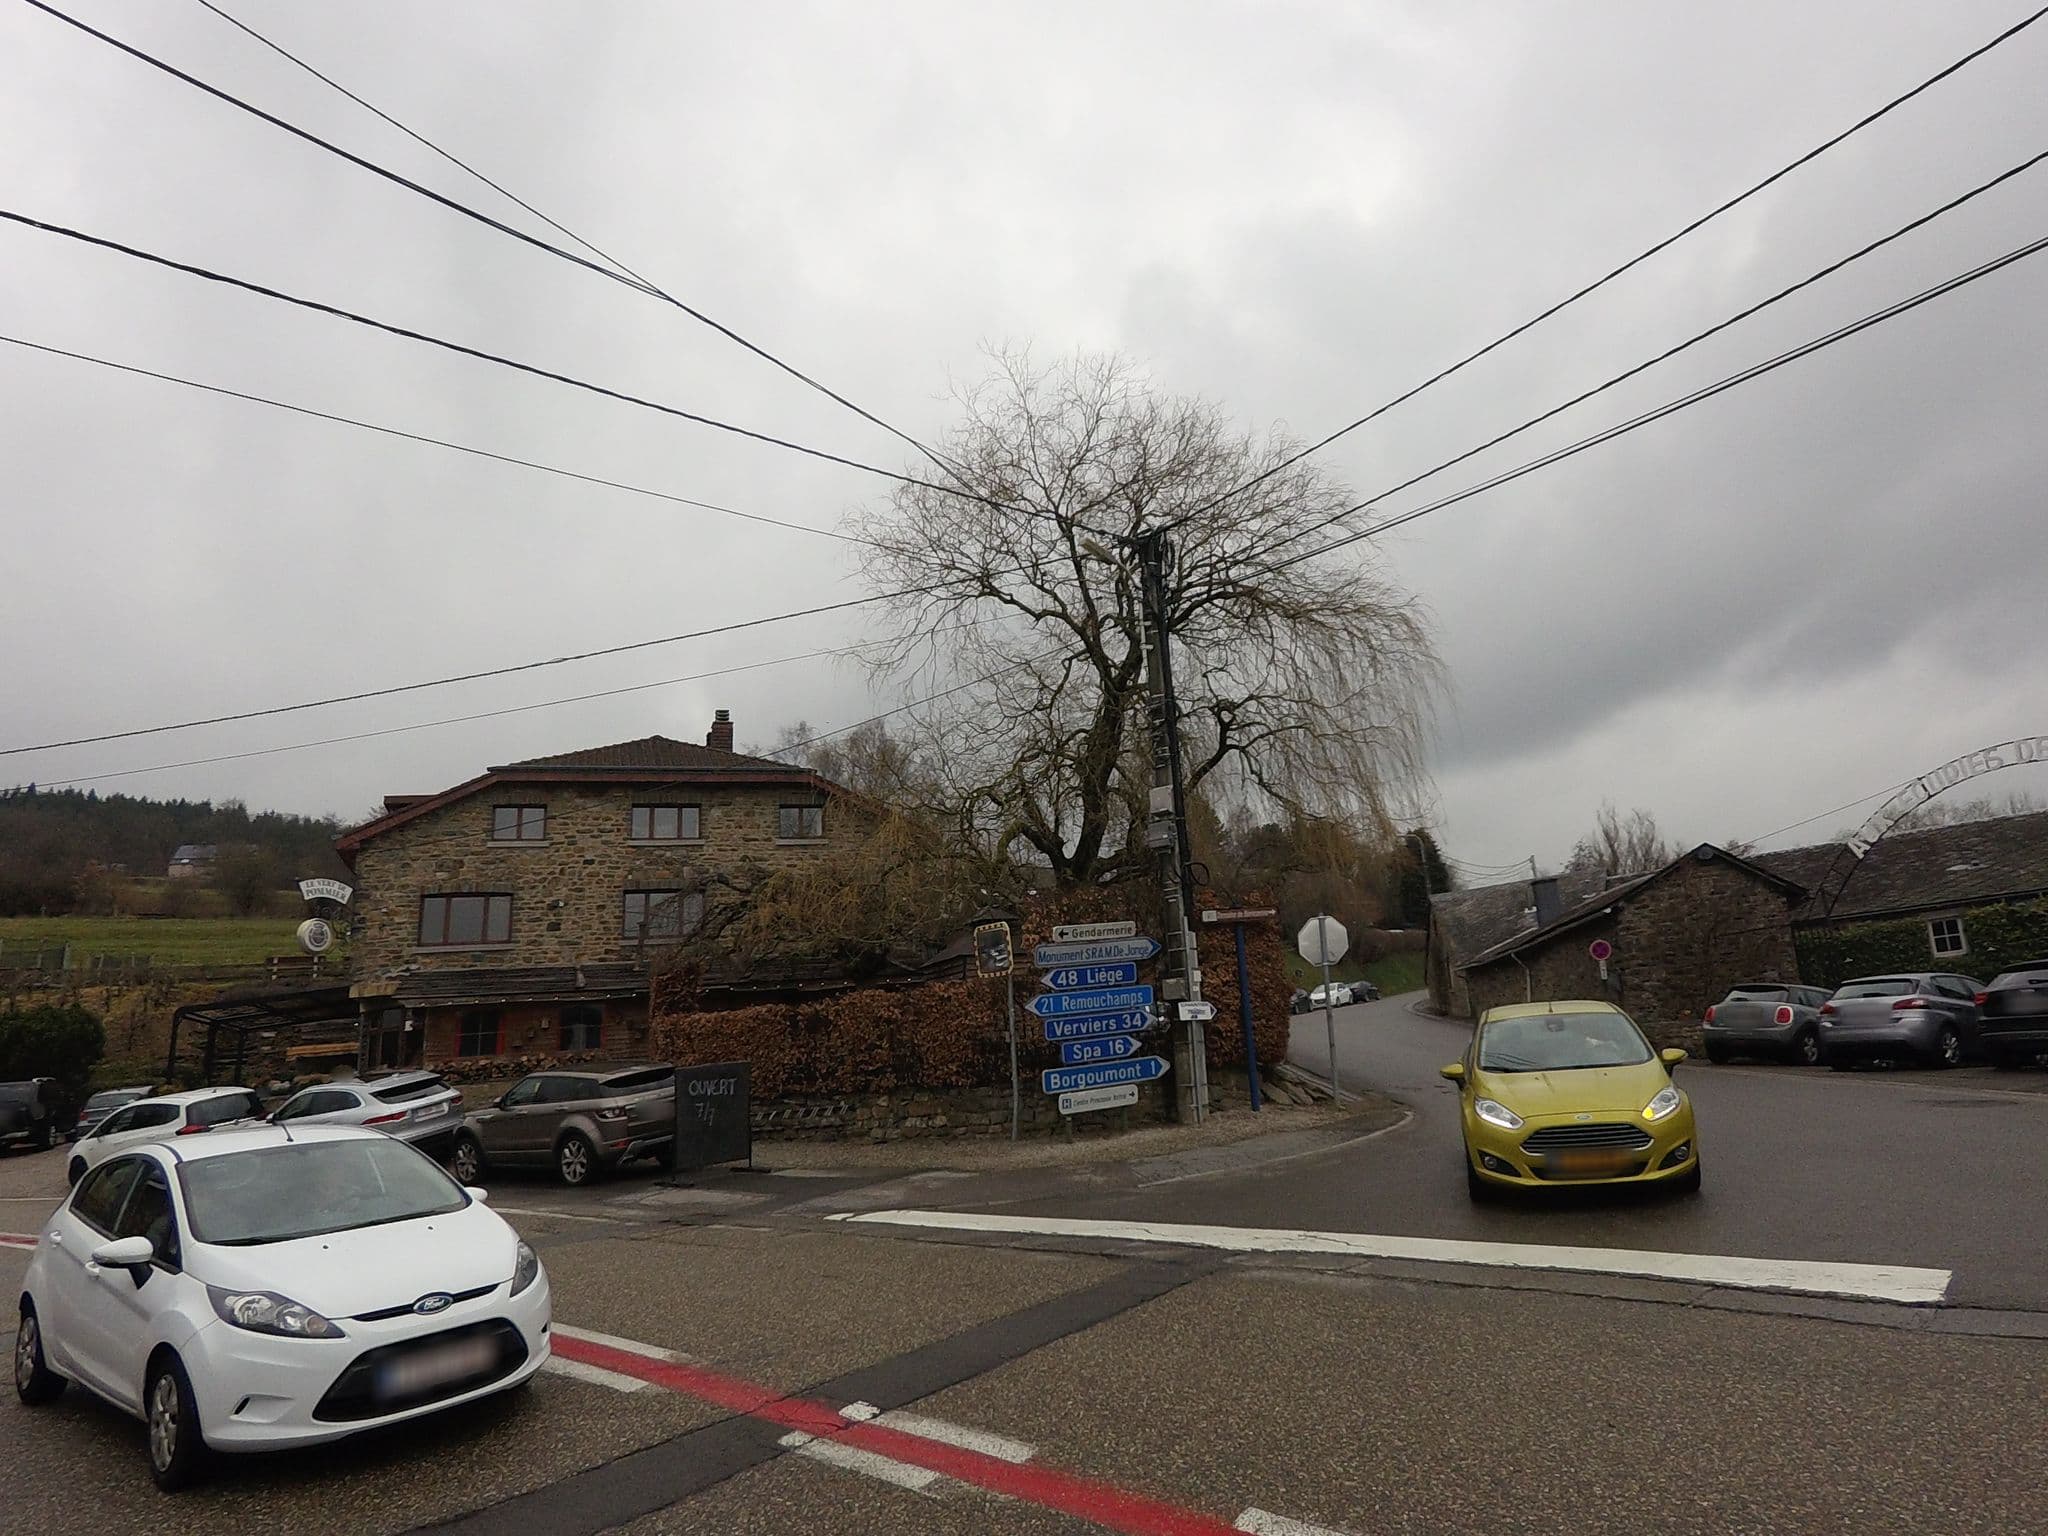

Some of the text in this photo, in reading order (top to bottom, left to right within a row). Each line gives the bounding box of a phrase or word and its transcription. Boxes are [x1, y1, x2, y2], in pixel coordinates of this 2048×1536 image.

[306, 887, 348, 901] POMMIER
[1071, 926, 1133, 938] Gendarmerie
[1039, 949, 1083, 962] Monument
[1057, 968, 1123, 986] 48 Liège
[1041, 991, 1143, 1013] 21 Remouchamps
[1053, 1013, 1142, 1036] Verviers 34
[1073, 1039, 1124, 1060] Spa 16
[1051, 1060, 1156, 1089] Borgoumont 1
[688, 1077, 738, 1096] OUVERT
[422, 1297, 445, 1310] Ford
